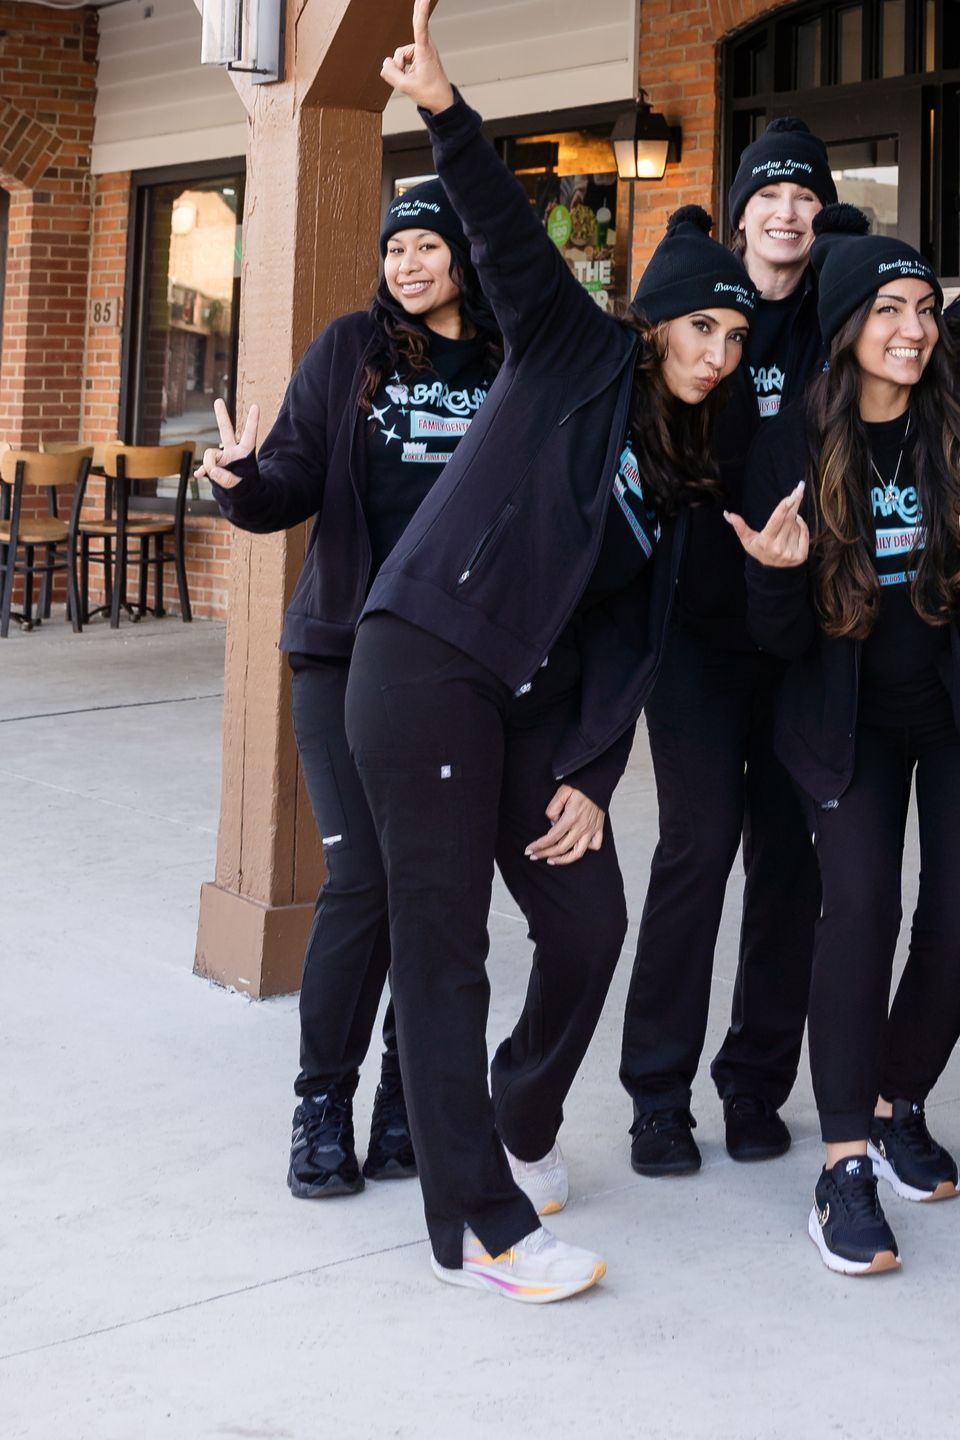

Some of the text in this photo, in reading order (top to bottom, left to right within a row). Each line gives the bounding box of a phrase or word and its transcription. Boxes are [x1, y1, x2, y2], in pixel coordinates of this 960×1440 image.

[766, 167, 795, 177] Dental
[784, 159, 813, 174] Family
[412, 200, 441, 213] Family
[574, 260, 611, 284] THE
[878, 258, 912, 274] Barclay
[714, 281, 749, 297] Barclay
[93, 302, 112, 323] 85
[408, 381, 488, 415] BARCLA
[418, 420, 444, 431] FAMILY
